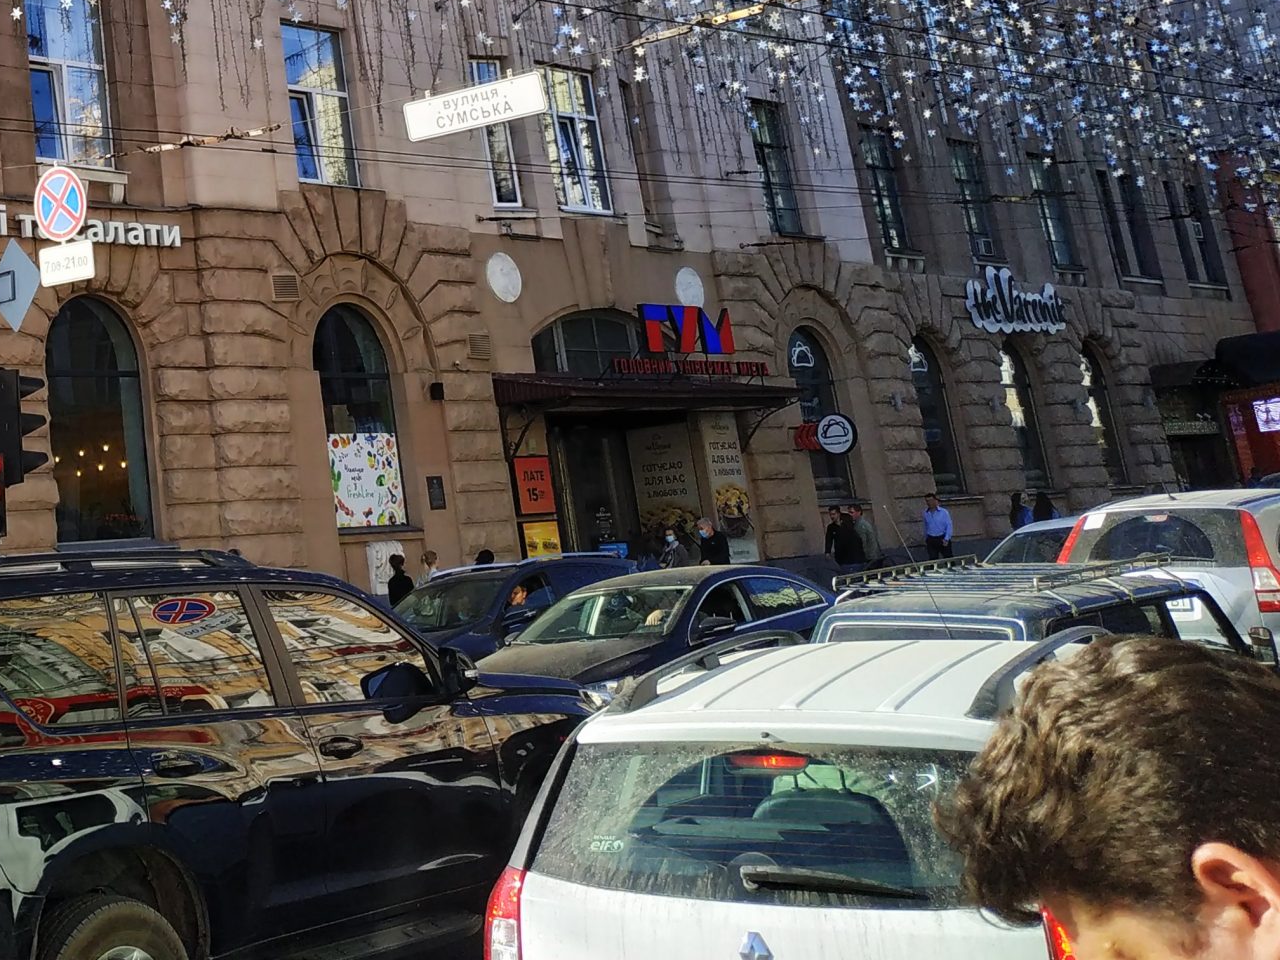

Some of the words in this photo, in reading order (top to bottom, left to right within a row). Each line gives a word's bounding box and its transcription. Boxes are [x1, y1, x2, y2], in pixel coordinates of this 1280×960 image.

[442, 88, 499, 111] вулиця
[436, 100, 514, 129] СУМСЬКА
[637, 304, 735, 355] ГУМ
[523, 470, 545, 482] ЛАТЕ
[526, 487, 539, 502] 15
[591, 840, 613, 851] elf
